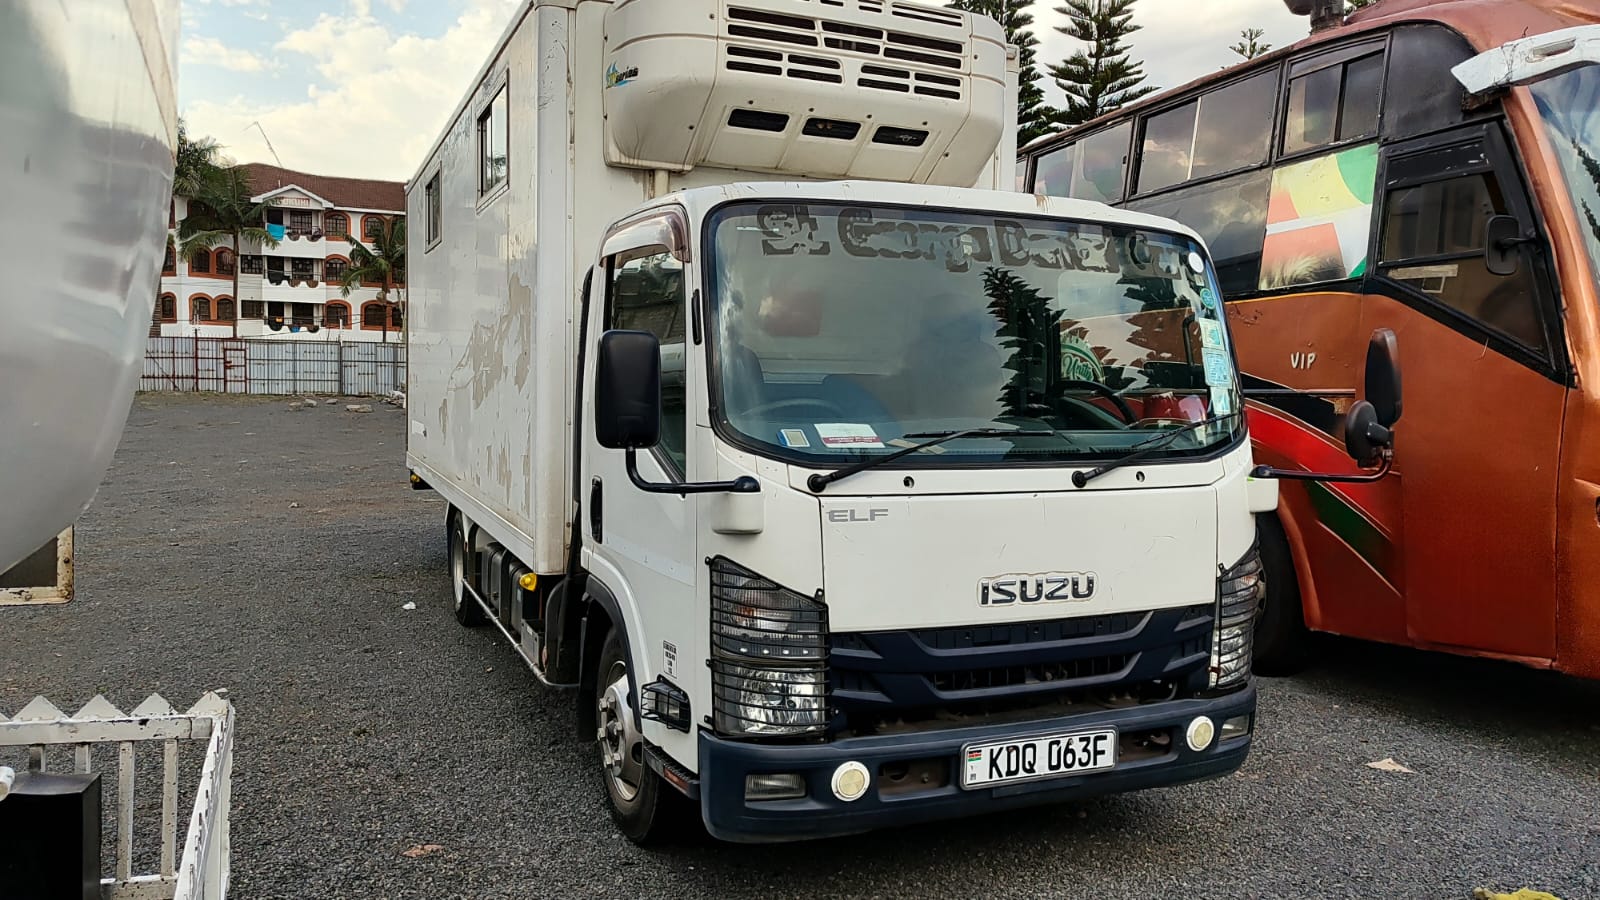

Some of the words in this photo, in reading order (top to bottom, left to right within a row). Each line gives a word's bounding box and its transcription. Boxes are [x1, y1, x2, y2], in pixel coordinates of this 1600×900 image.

[1290, 351, 1317, 369] VIP
[828, 508, 889, 523] ELF
[980, 575, 1095, 605] ISUZU
[988, 742, 1037, 780] KDQ
[1047, 734, 1108, 772] 063F
